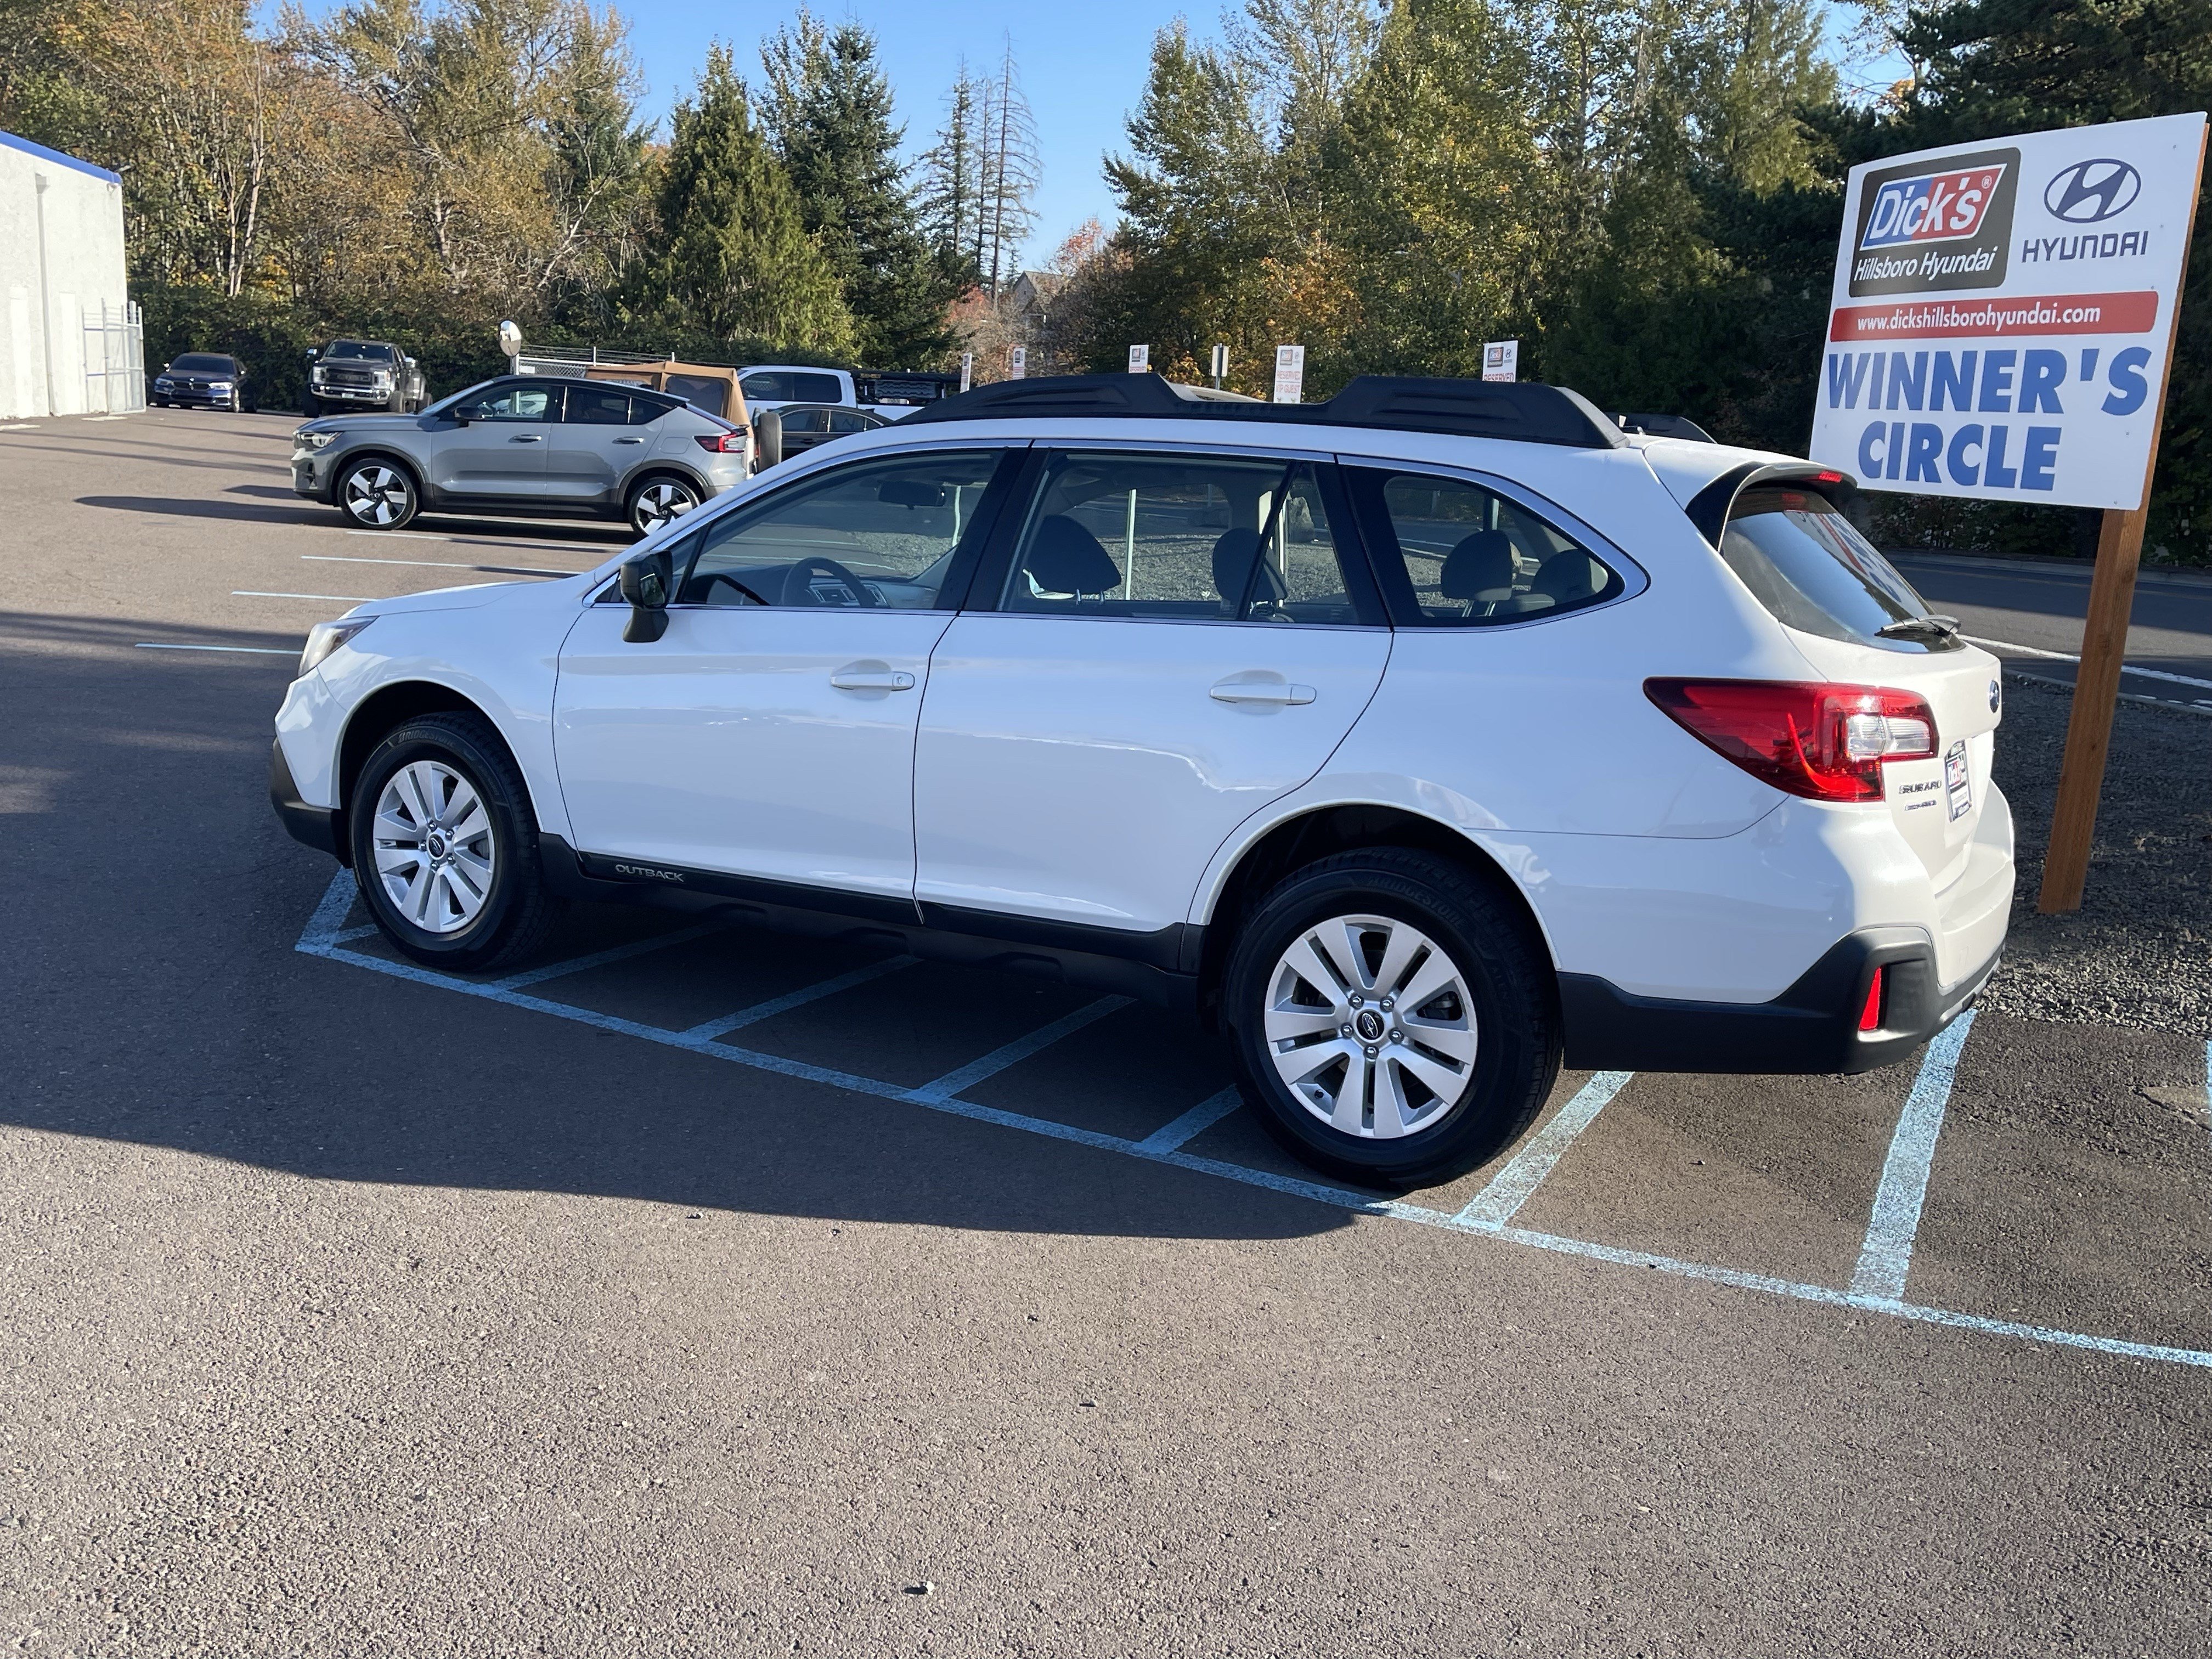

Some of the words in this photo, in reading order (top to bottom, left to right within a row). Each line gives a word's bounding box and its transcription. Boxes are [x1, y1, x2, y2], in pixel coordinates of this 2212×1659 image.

[1854, 256, 1918, 281] Hillsboro
[1919, 246, 1998, 281] Hyundai
[2021, 230, 2149, 263] HYUNDAI
[1858, 301, 2101, 332] www.dickshillsborohyundai.com
[1829, 347, 2152, 415] WINNER'S
[1858, 421, 2062, 490] CIRCLE
[615, 864, 684, 882] OUTBACK
